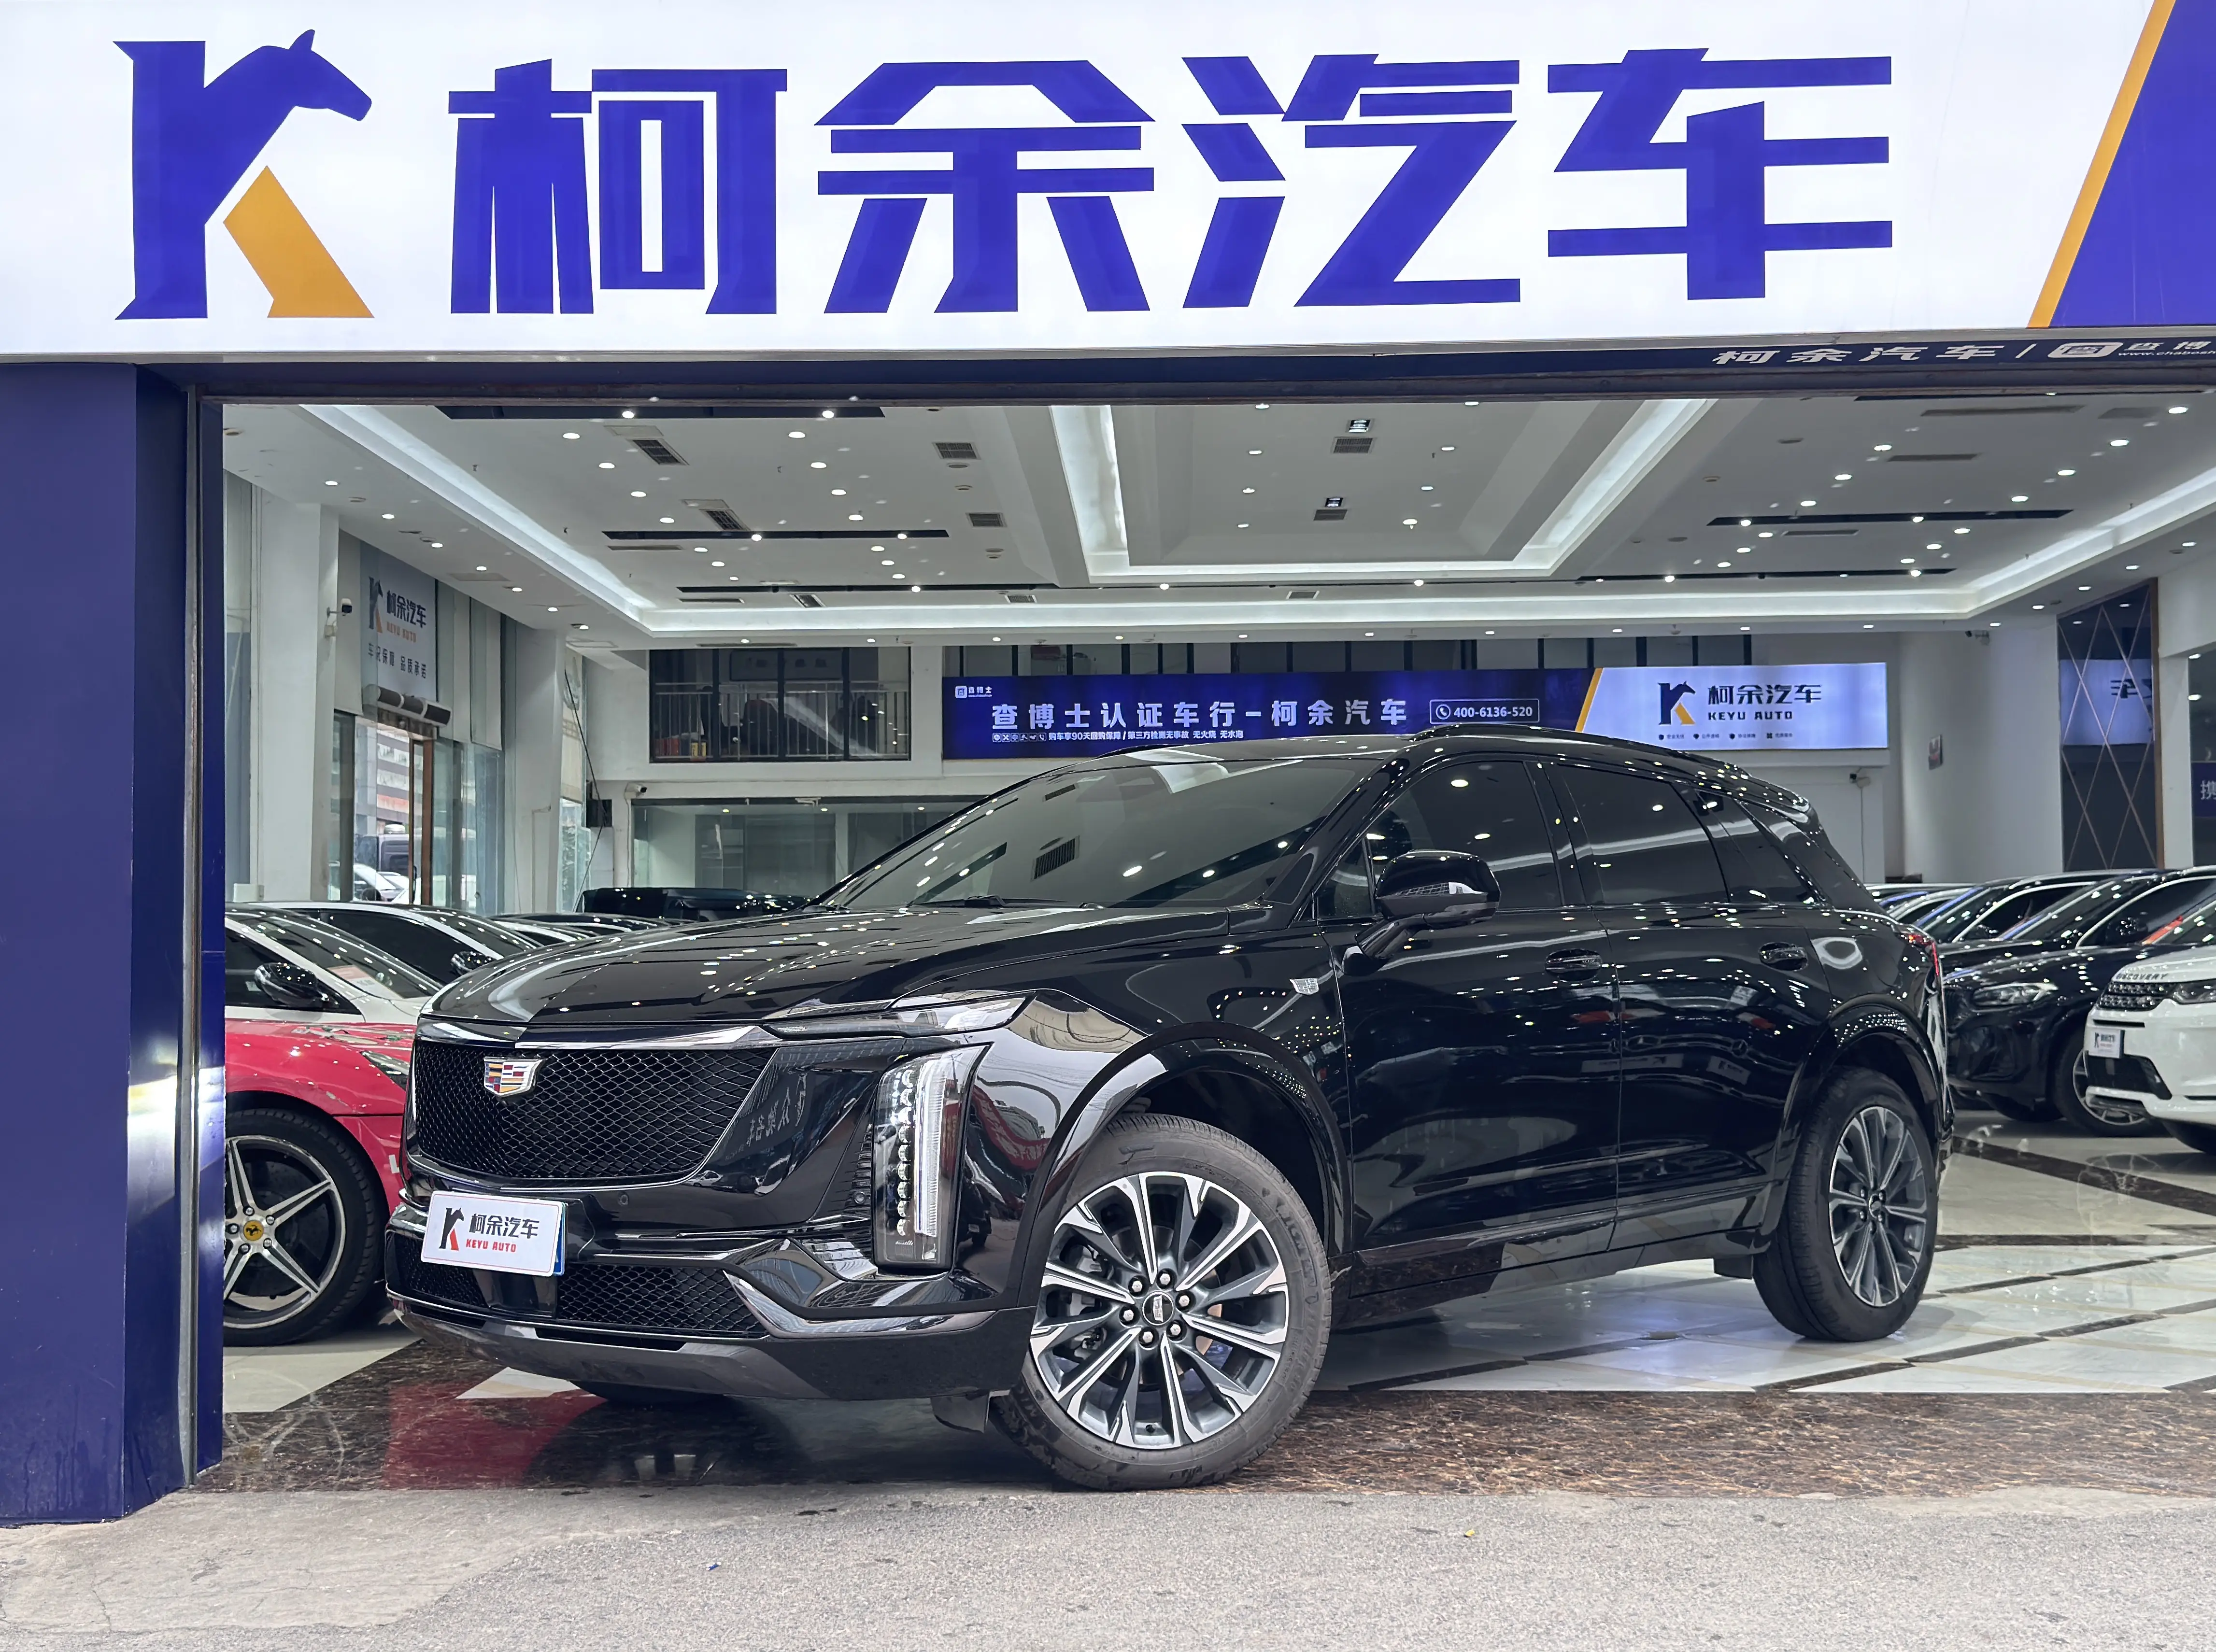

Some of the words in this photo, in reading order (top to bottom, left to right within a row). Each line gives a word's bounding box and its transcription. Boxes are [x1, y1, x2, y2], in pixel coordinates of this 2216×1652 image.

[448, 48, 1892, 315] 柯余汽车
[1712, 345, 2005, 365] 柯余汽车
[386, 590, 426, 628] 柯余汽车
[1707, 684, 1821, 705] 柯余汽车
[1453, 706, 1533, 718] 400-6136-520
[1708, 712, 1746, 720] KEYU
[1755, 711, 1793, 720] AUTO
[469, 1213, 540, 1239] 柯余汽车
[466, 1239, 489, 1249] KEYU
[492, 1242, 517, 1253] AUTO
